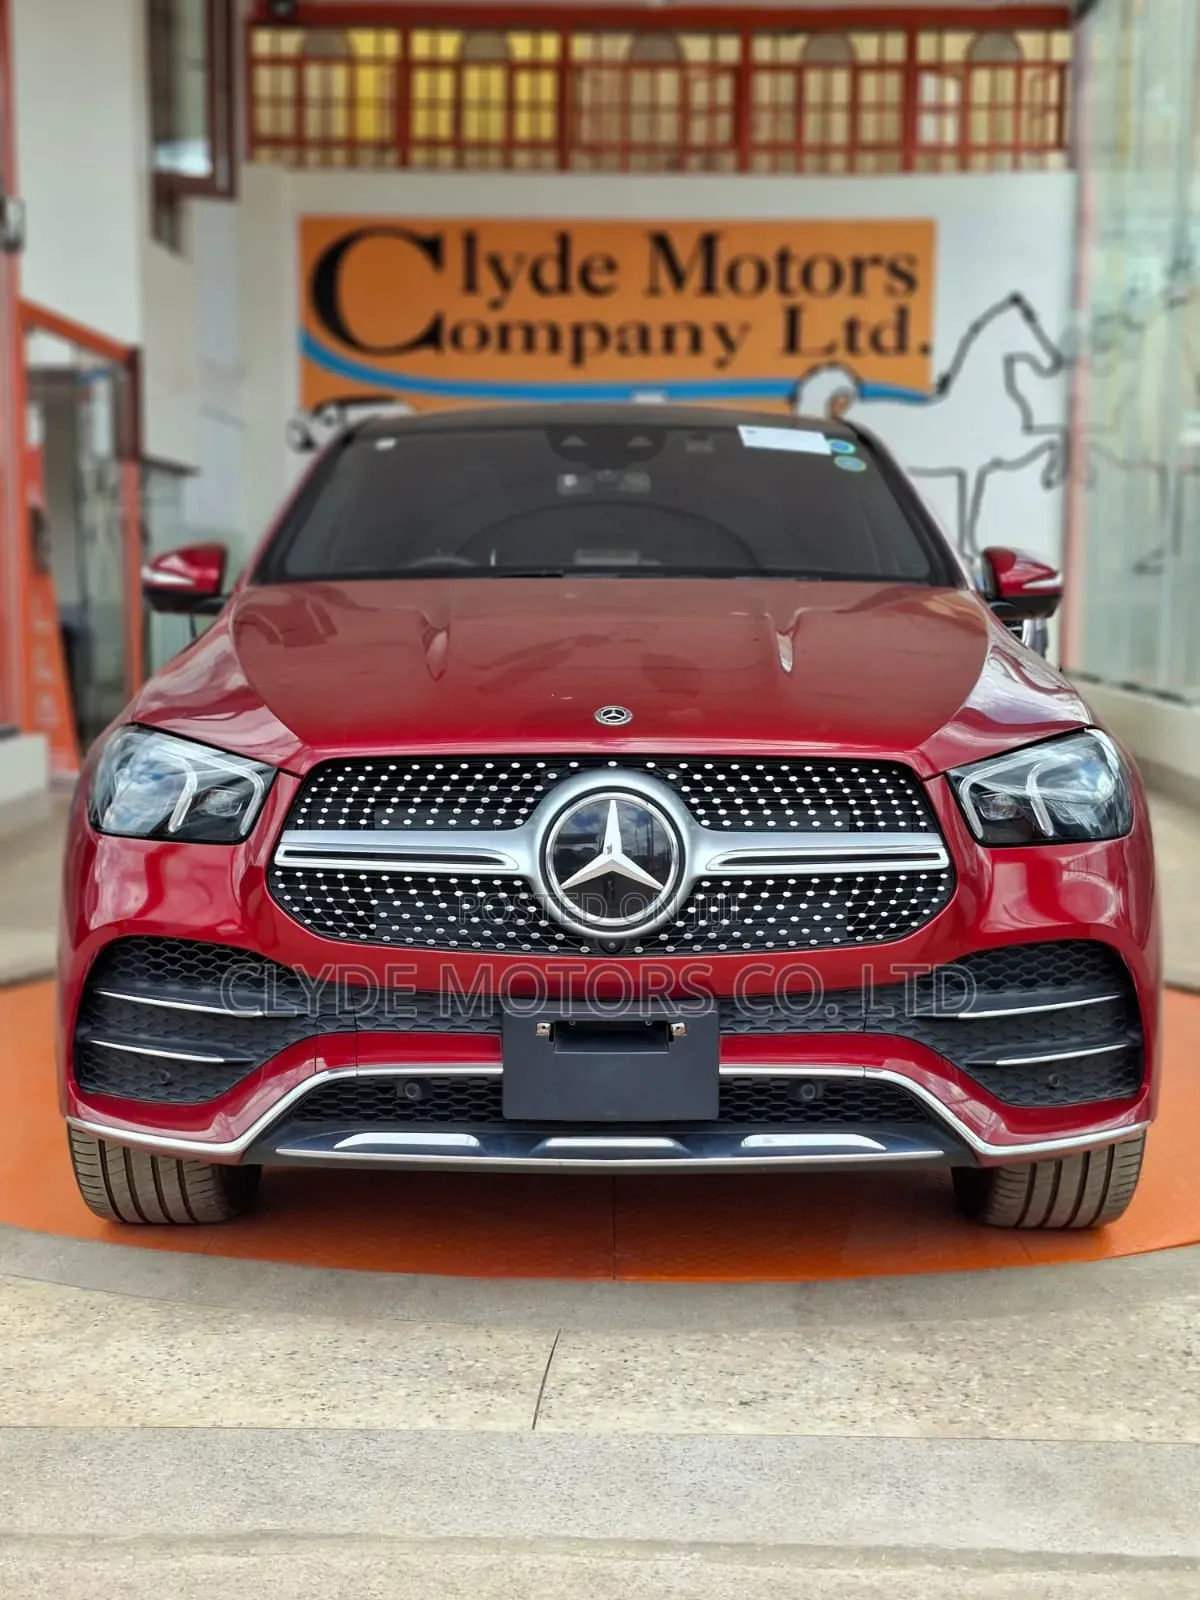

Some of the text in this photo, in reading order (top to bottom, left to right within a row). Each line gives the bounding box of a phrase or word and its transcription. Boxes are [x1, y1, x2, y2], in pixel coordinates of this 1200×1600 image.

[309, 226, 918, 357] Clyde Motors
[782, 304, 933, 357] Ltd.
